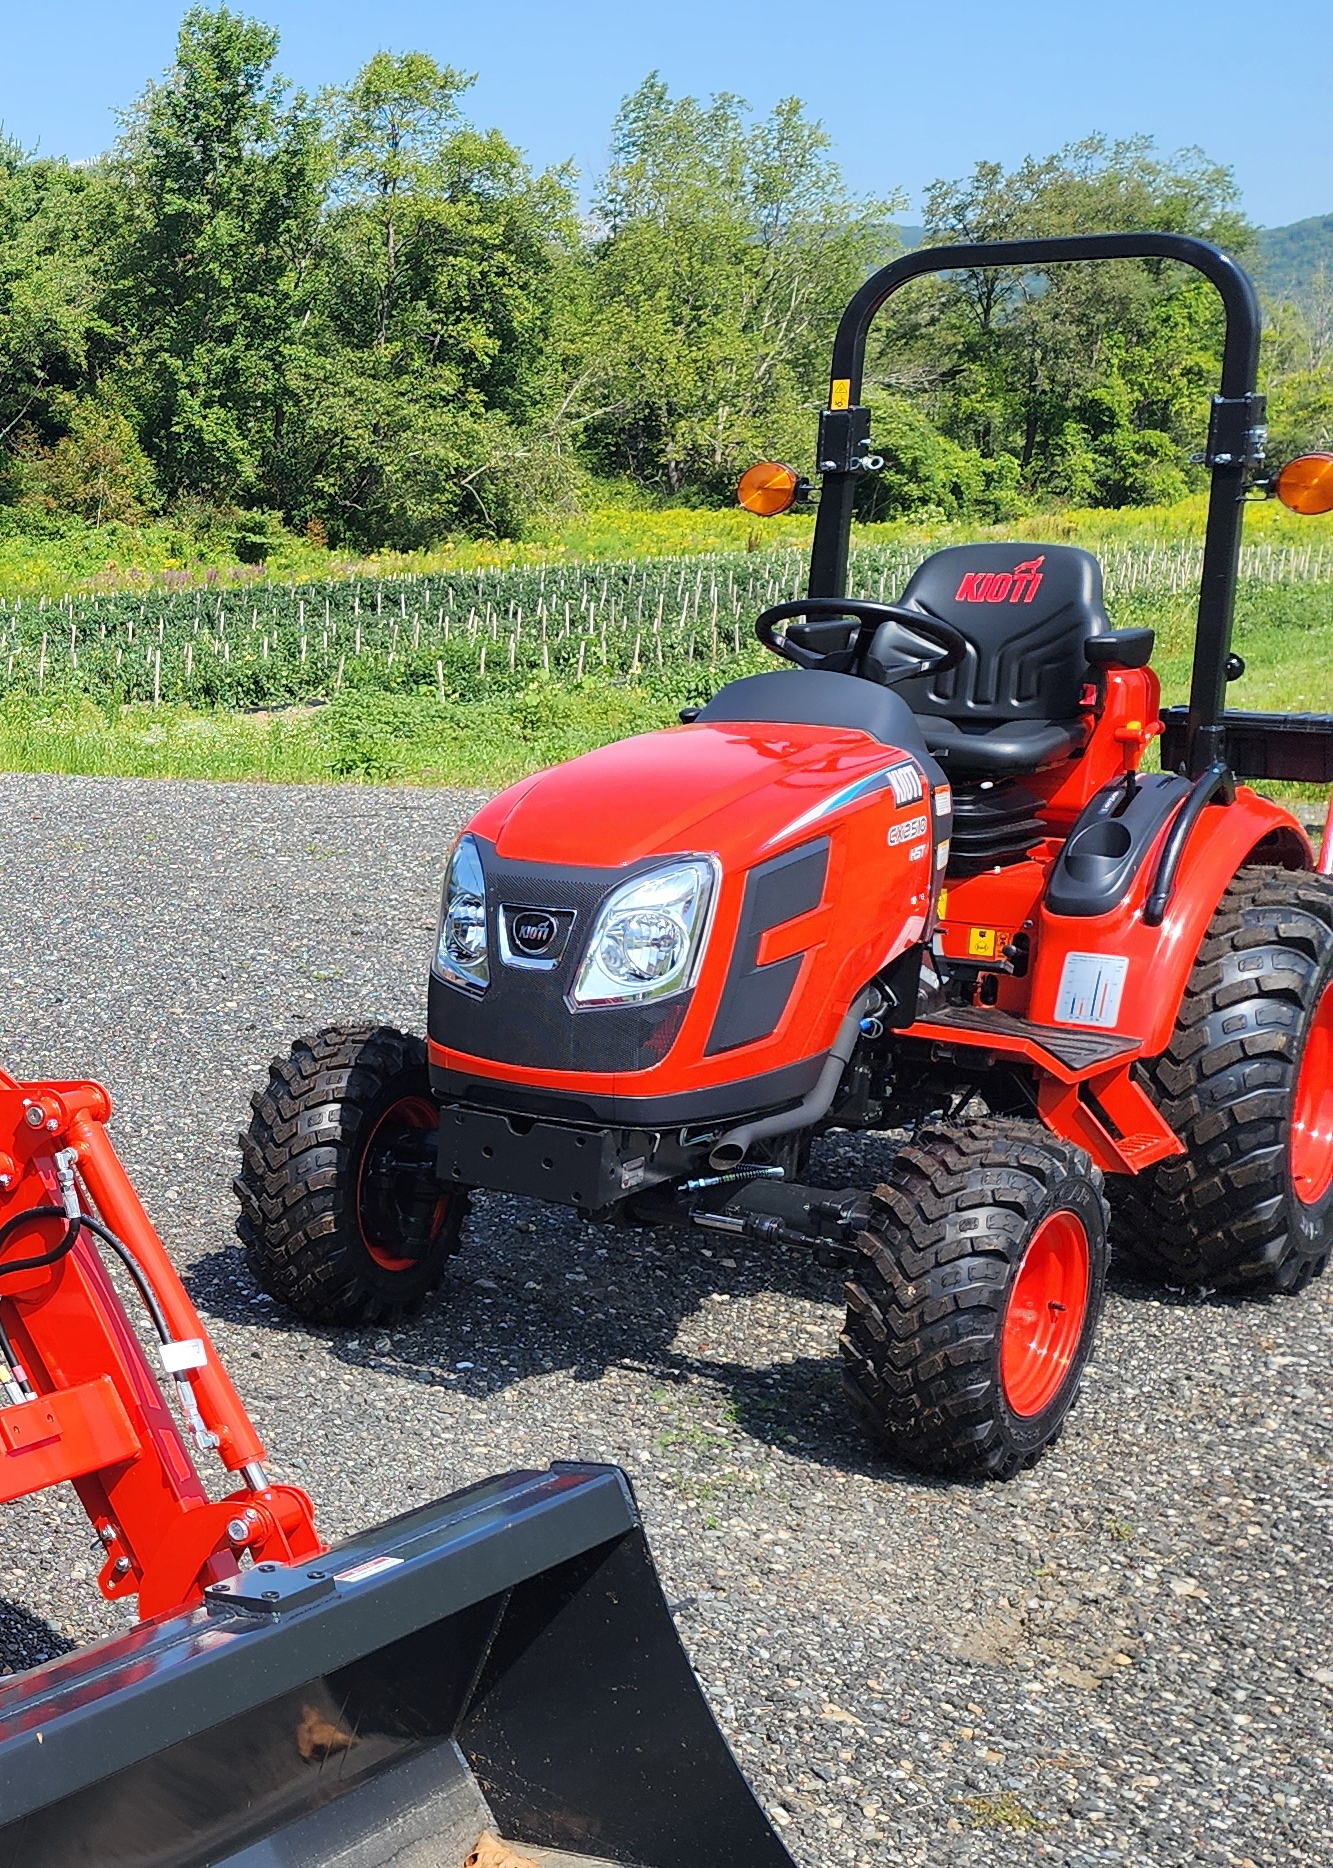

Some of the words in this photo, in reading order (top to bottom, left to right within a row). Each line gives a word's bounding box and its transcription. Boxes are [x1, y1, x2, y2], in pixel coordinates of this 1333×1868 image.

[955, 572, 1044, 603] KIOTI
[885, 765, 923, 804] KIOTI
[518, 925, 549, 940] KIOTI
